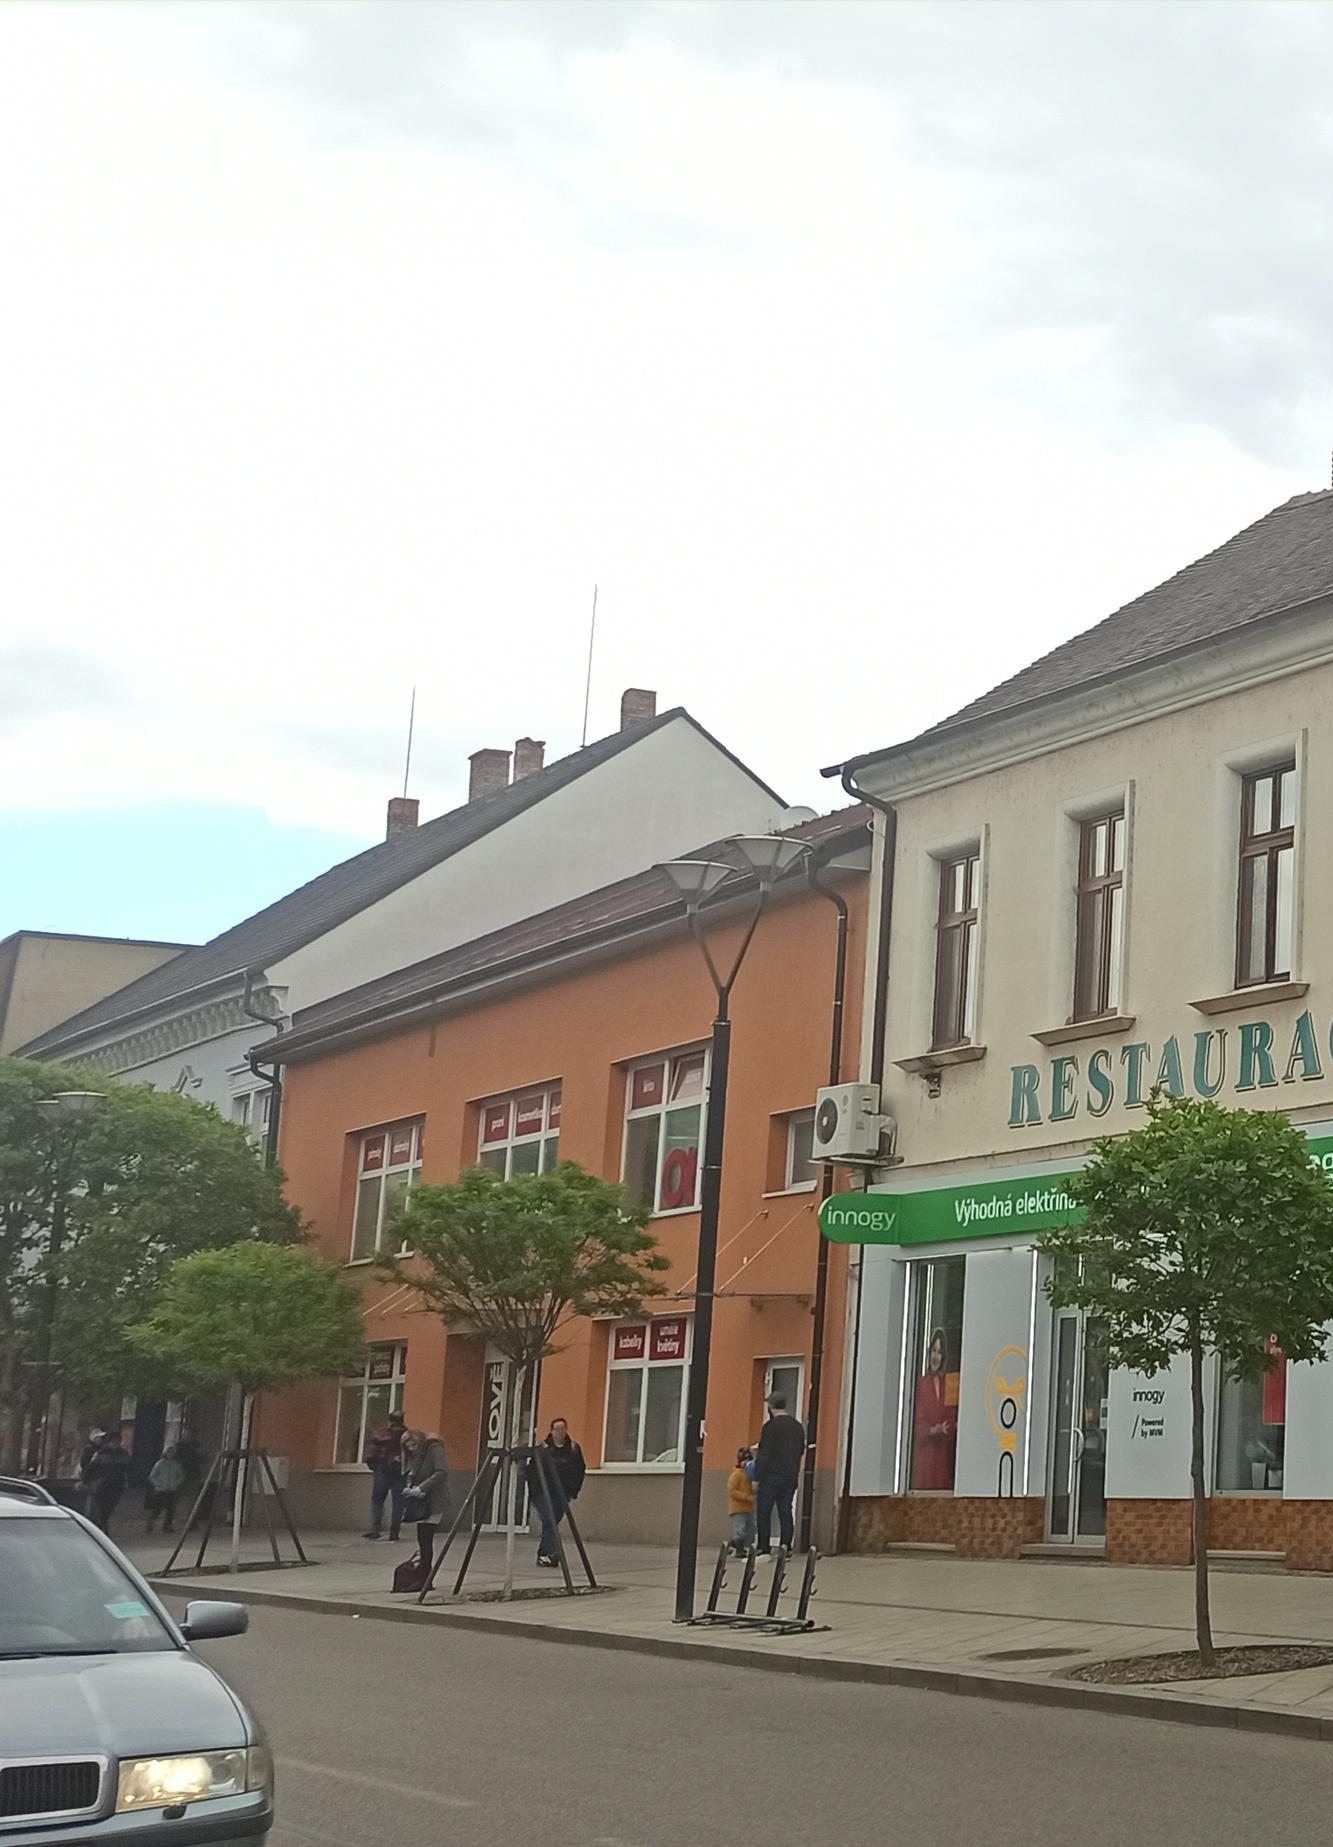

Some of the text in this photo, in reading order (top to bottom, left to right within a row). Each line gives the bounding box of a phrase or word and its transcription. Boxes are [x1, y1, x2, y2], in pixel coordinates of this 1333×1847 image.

[826, 1205, 897, 1232] innogy
[954, 1192, 1013, 1228] Výhodná
[1132, 1387, 1165, 1405] innogy
